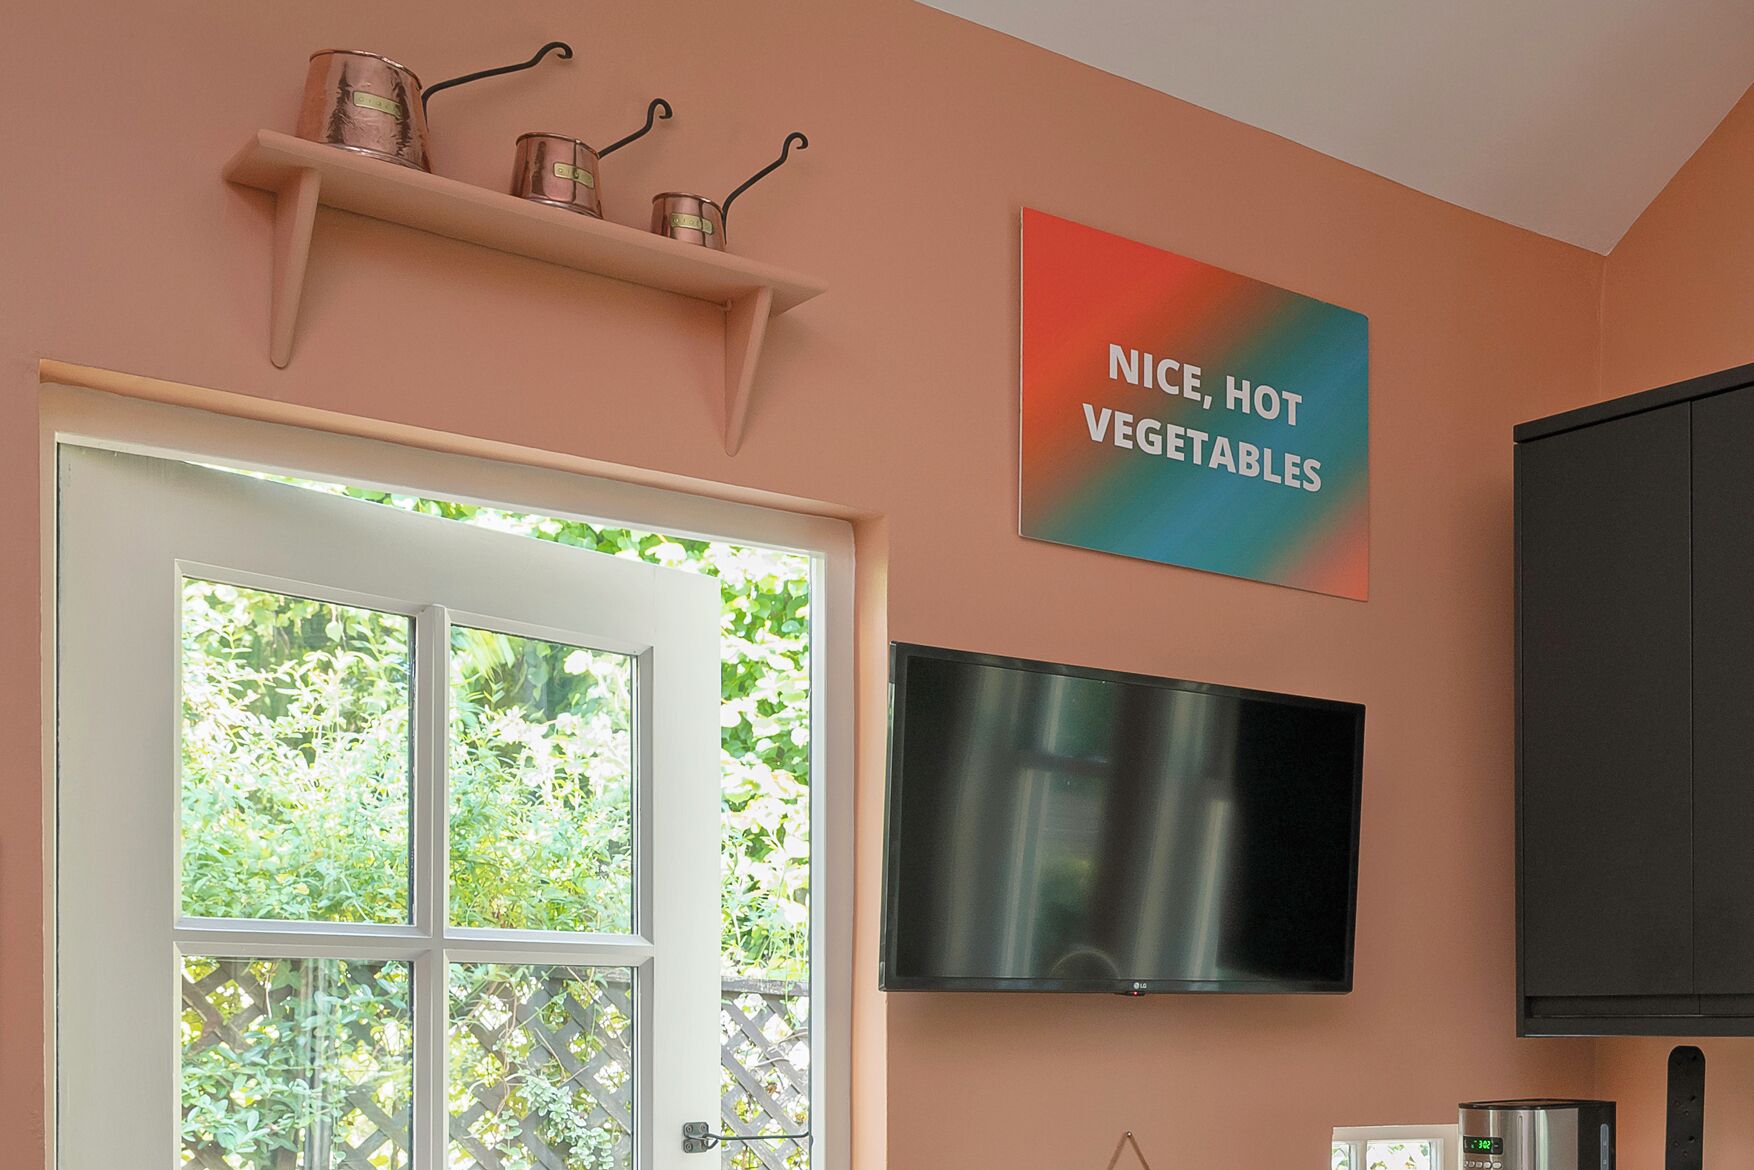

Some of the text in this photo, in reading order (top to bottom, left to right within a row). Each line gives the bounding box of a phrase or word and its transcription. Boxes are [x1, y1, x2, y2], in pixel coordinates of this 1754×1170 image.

[1109, 344, 1303, 426] NICE, HOT
[1082, 403, 1322, 492] VEGETABLES
